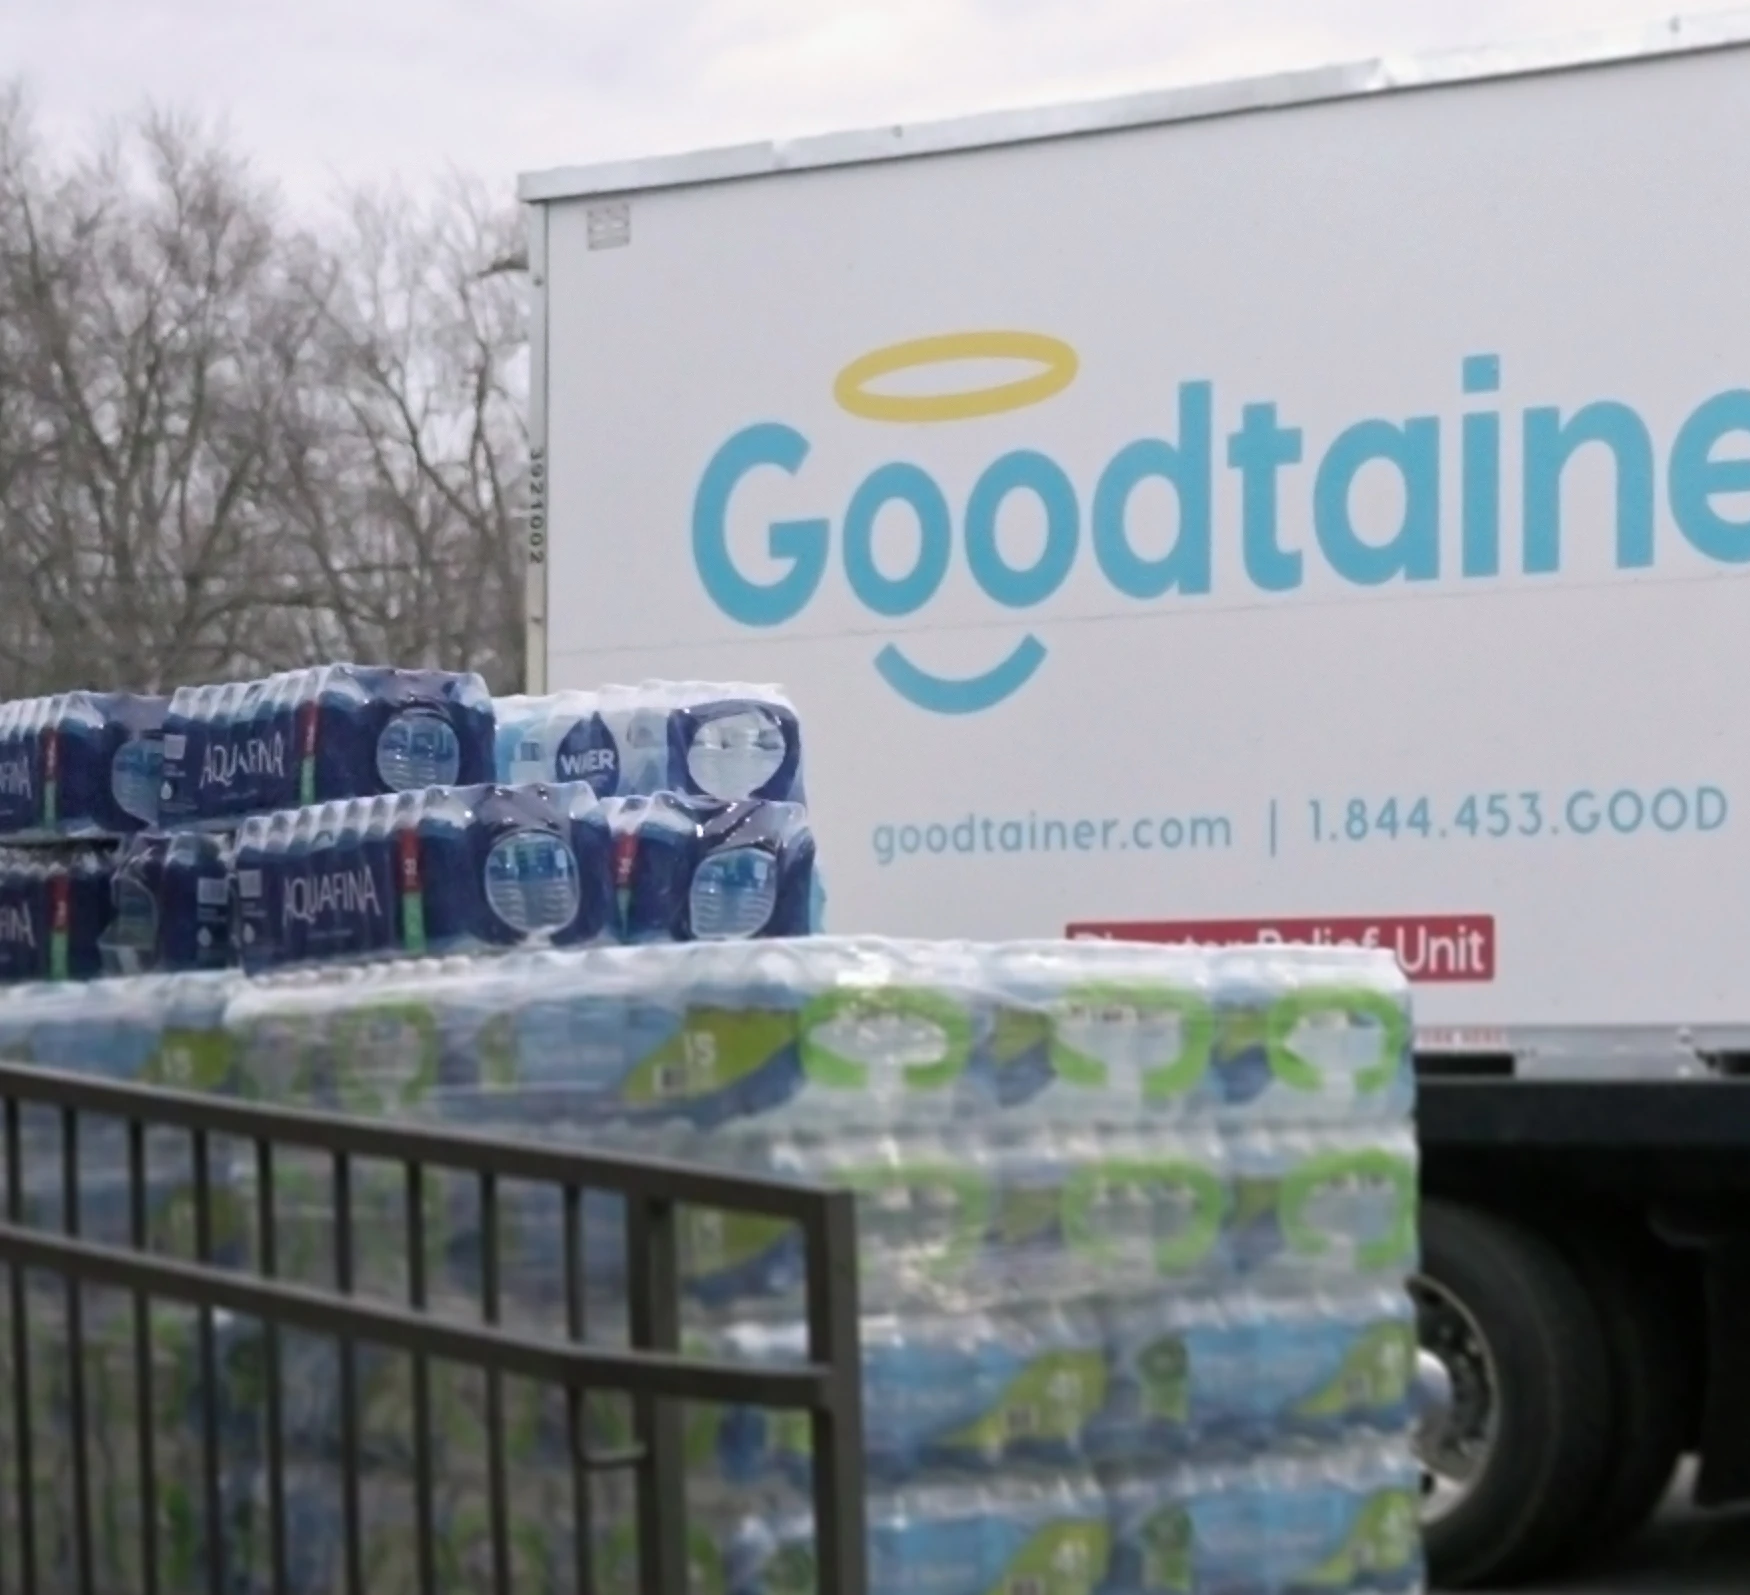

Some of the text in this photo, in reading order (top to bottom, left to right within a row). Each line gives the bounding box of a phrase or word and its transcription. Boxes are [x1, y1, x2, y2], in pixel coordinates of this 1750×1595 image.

[560, 748, 615, 776] WER
[871, 811, 1232, 866] goodtainer.com
[1309, 786, 1728, 841] 1.844.453.GOOD
[282, 864, 382, 928] AQUAFINA
[1396, 925, 1486, 972] Unit
